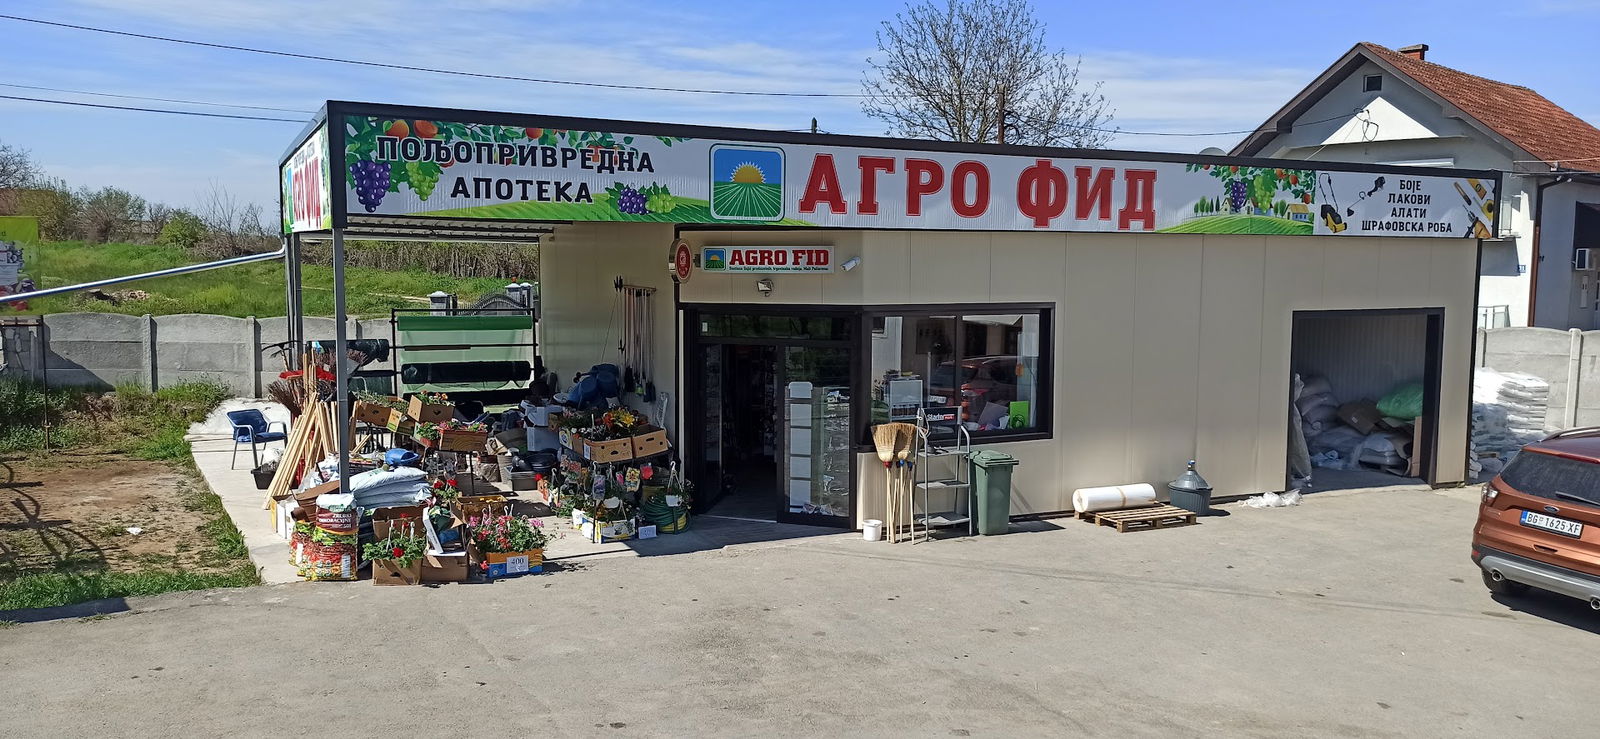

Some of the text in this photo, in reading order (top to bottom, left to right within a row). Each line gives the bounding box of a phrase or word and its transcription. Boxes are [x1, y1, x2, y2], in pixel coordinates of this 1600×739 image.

[376, 136, 655, 174] ПОЉОПРИВРЕДНА
[450, 177, 593, 204] АПОТЕКА
[798, 153, 1158, 231] АГРО ФИД
[1399, 179, 1422, 193] БОЈЕ
[1388, 193, 1431, 205] ЛАКОВИ
[1391, 207, 1427, 219] АЛАТИ
[1361, 220, 1453, 233] ШРАФОВСКА РОБА
[729, 249, 829, 266] AGRO FID
[1527, 513, 1539, 523] BG
